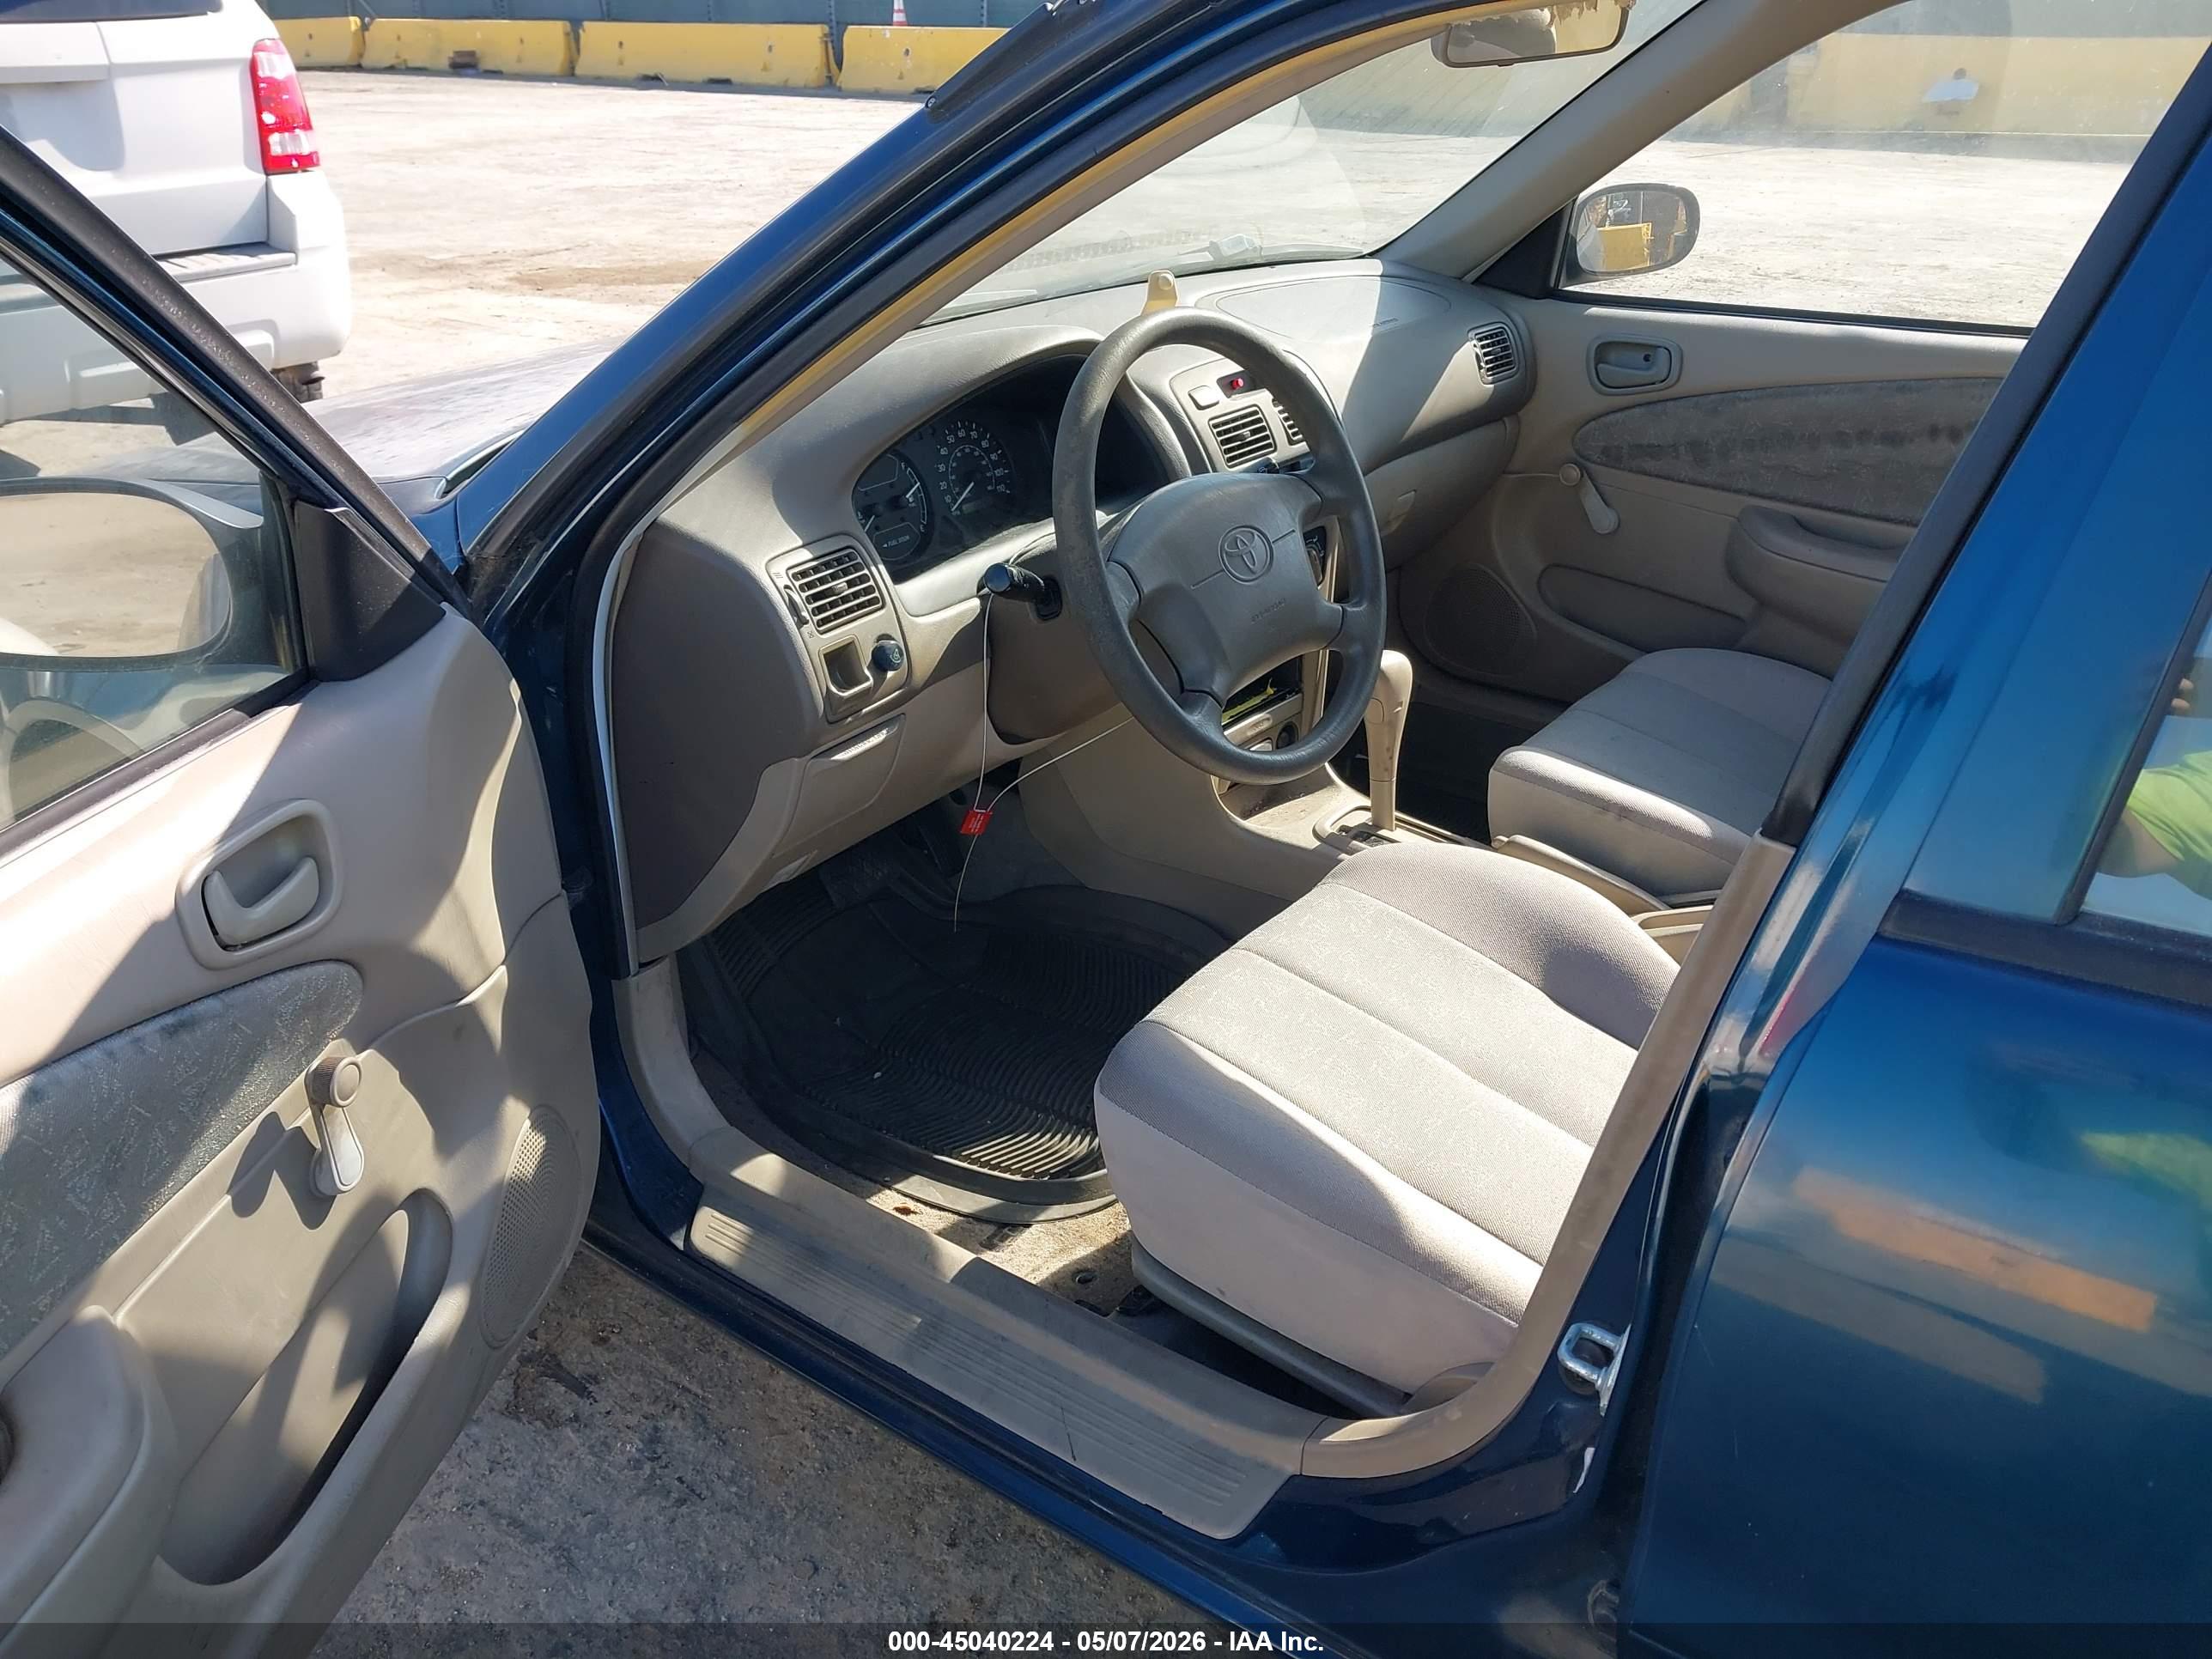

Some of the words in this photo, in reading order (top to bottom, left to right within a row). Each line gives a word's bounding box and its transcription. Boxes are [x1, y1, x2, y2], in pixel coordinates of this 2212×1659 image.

[957, 428, 966, 438] 60
[969, 430, 978, 440] 70
[946, 434, 955, 444] 50
[981, 439, 989, 448] 80
[939, 447, 949, 455] 40
[990, 453, 998, 461] 90
[938, 463, 945, 472] 30
[994, 467, 1004, 477] 100
[939, 481, 947, 490] 20
[945, 495, 952, 503] 10
